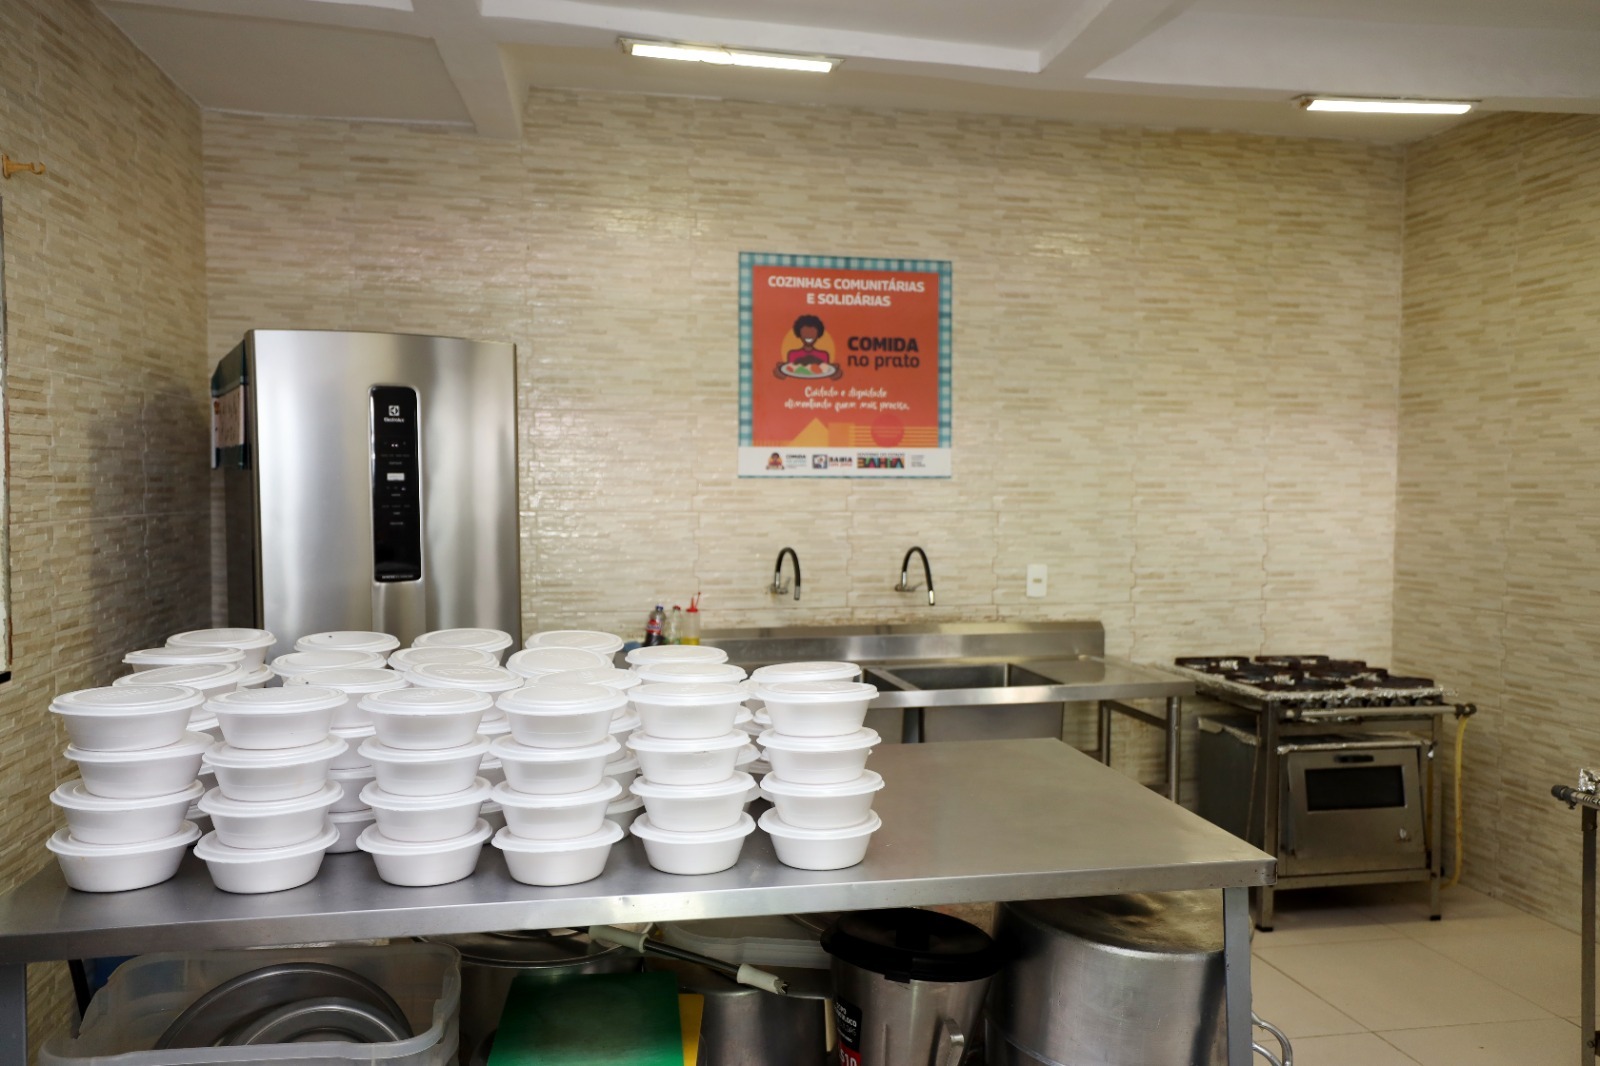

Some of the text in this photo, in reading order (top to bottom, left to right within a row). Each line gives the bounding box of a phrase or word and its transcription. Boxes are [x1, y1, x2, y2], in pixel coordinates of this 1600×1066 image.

[768, 276, 925, 292] COZINHAS COMUNITÁRIAS
[806, 293, 891, 306] E SOLIDÁRIAS
[847, 336, 919, 352] COMIDA
[848, 354, 920, 371] no prato
